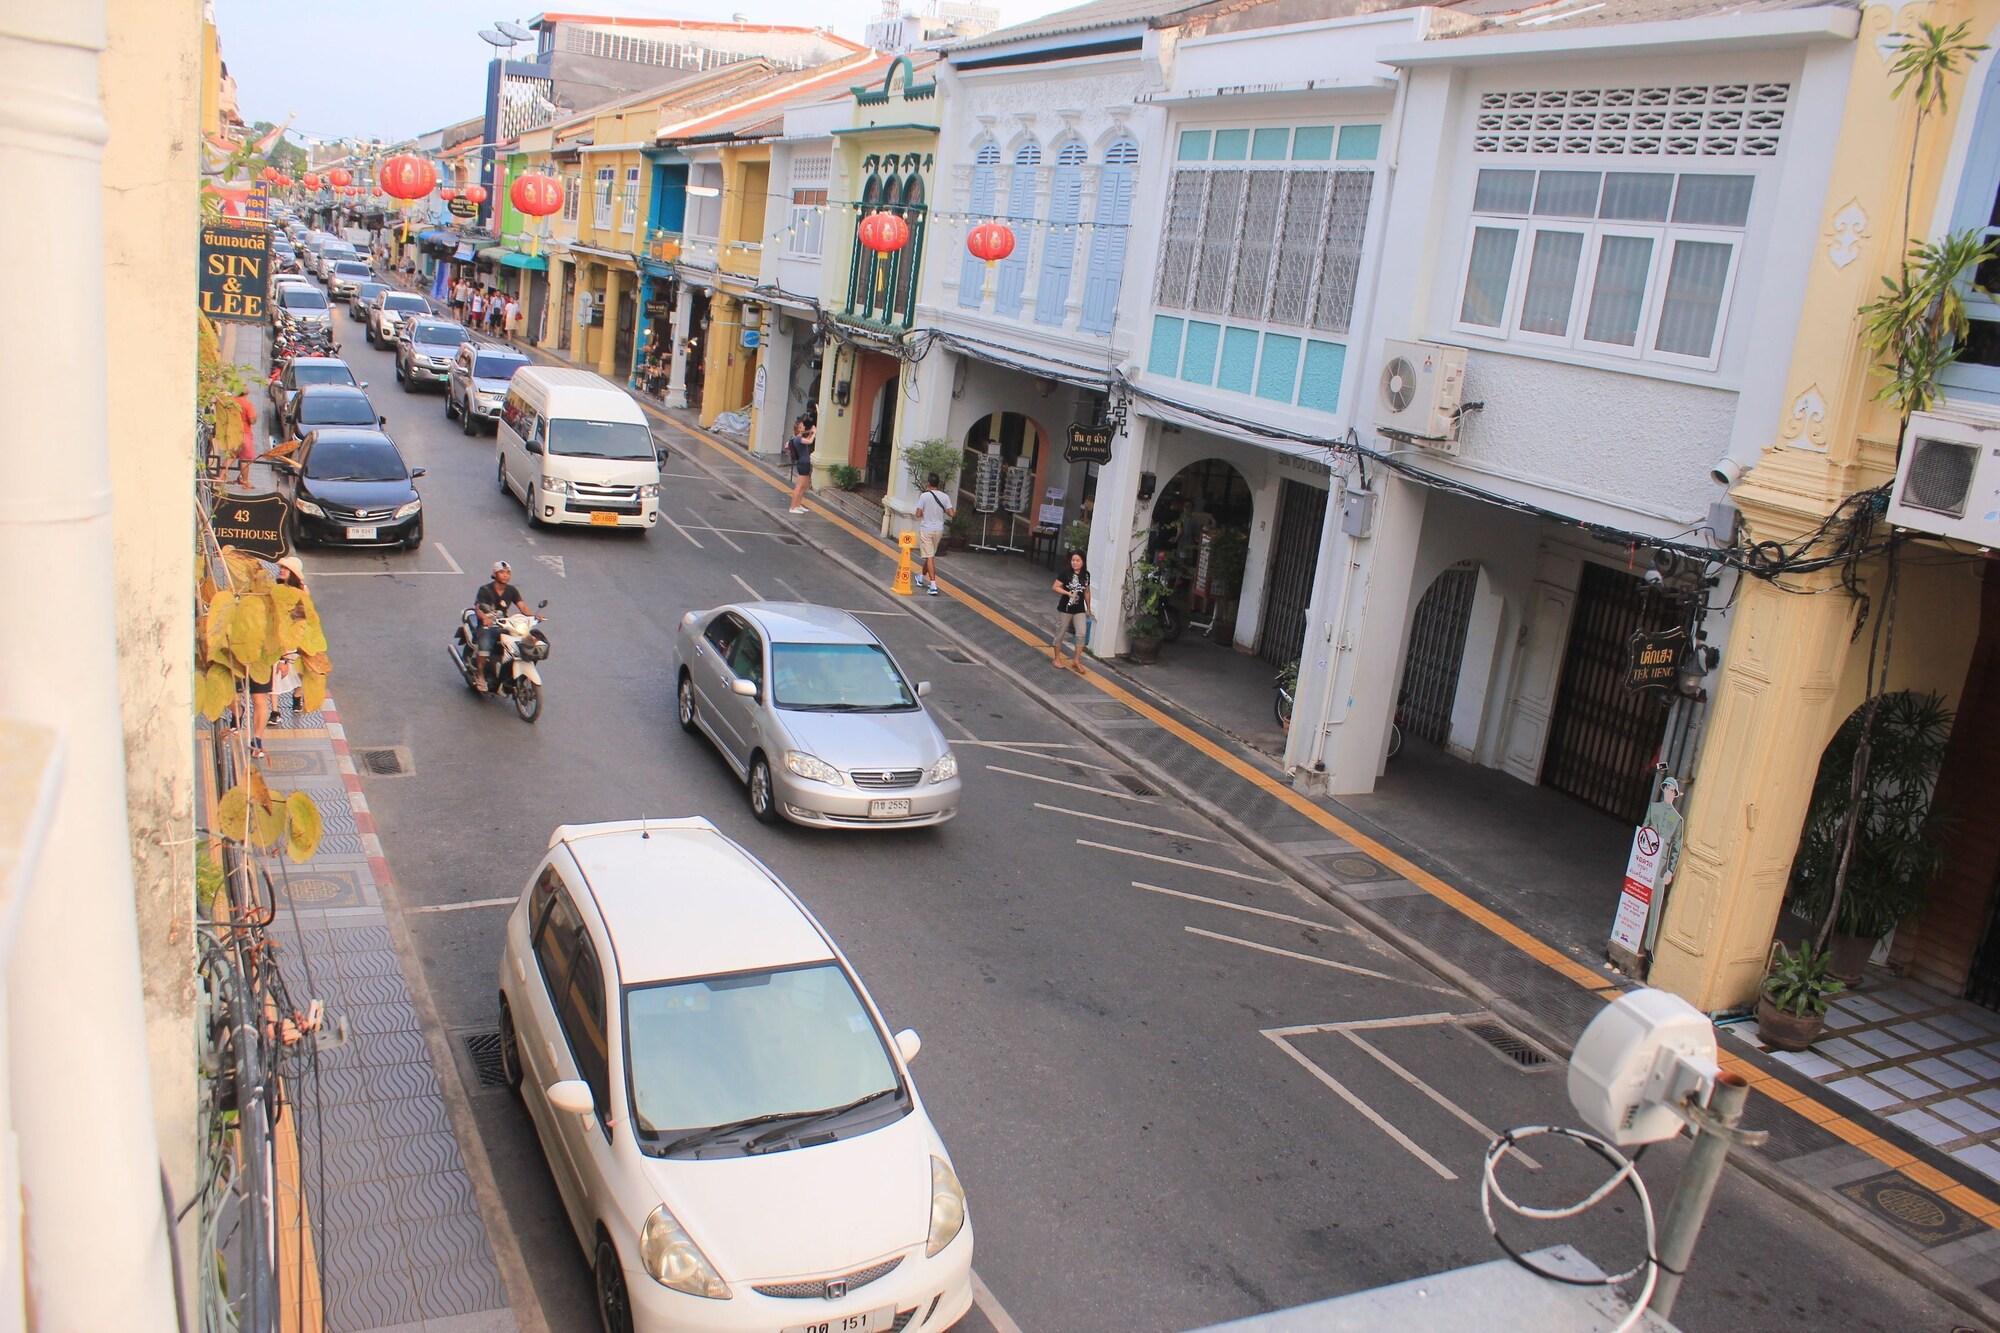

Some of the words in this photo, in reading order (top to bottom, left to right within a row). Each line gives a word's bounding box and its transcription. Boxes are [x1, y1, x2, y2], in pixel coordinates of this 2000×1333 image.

[204, 230, 266, 250] ซินแอนด์ลี
[208, 253, 261, 279] SIN
[222, 276, 242, 293] &
[200, 290, 262, 317] LEE
[234, 509, 250, 522] 43
[213, 527, 278, 541] UESTHOUSE
[1633, 668, 1648, 680] TEK
[1651, 666, 1675, 678] HENG
[888, 800, 908, 810] 2552
[842, 1314, 867, 1331] 151
